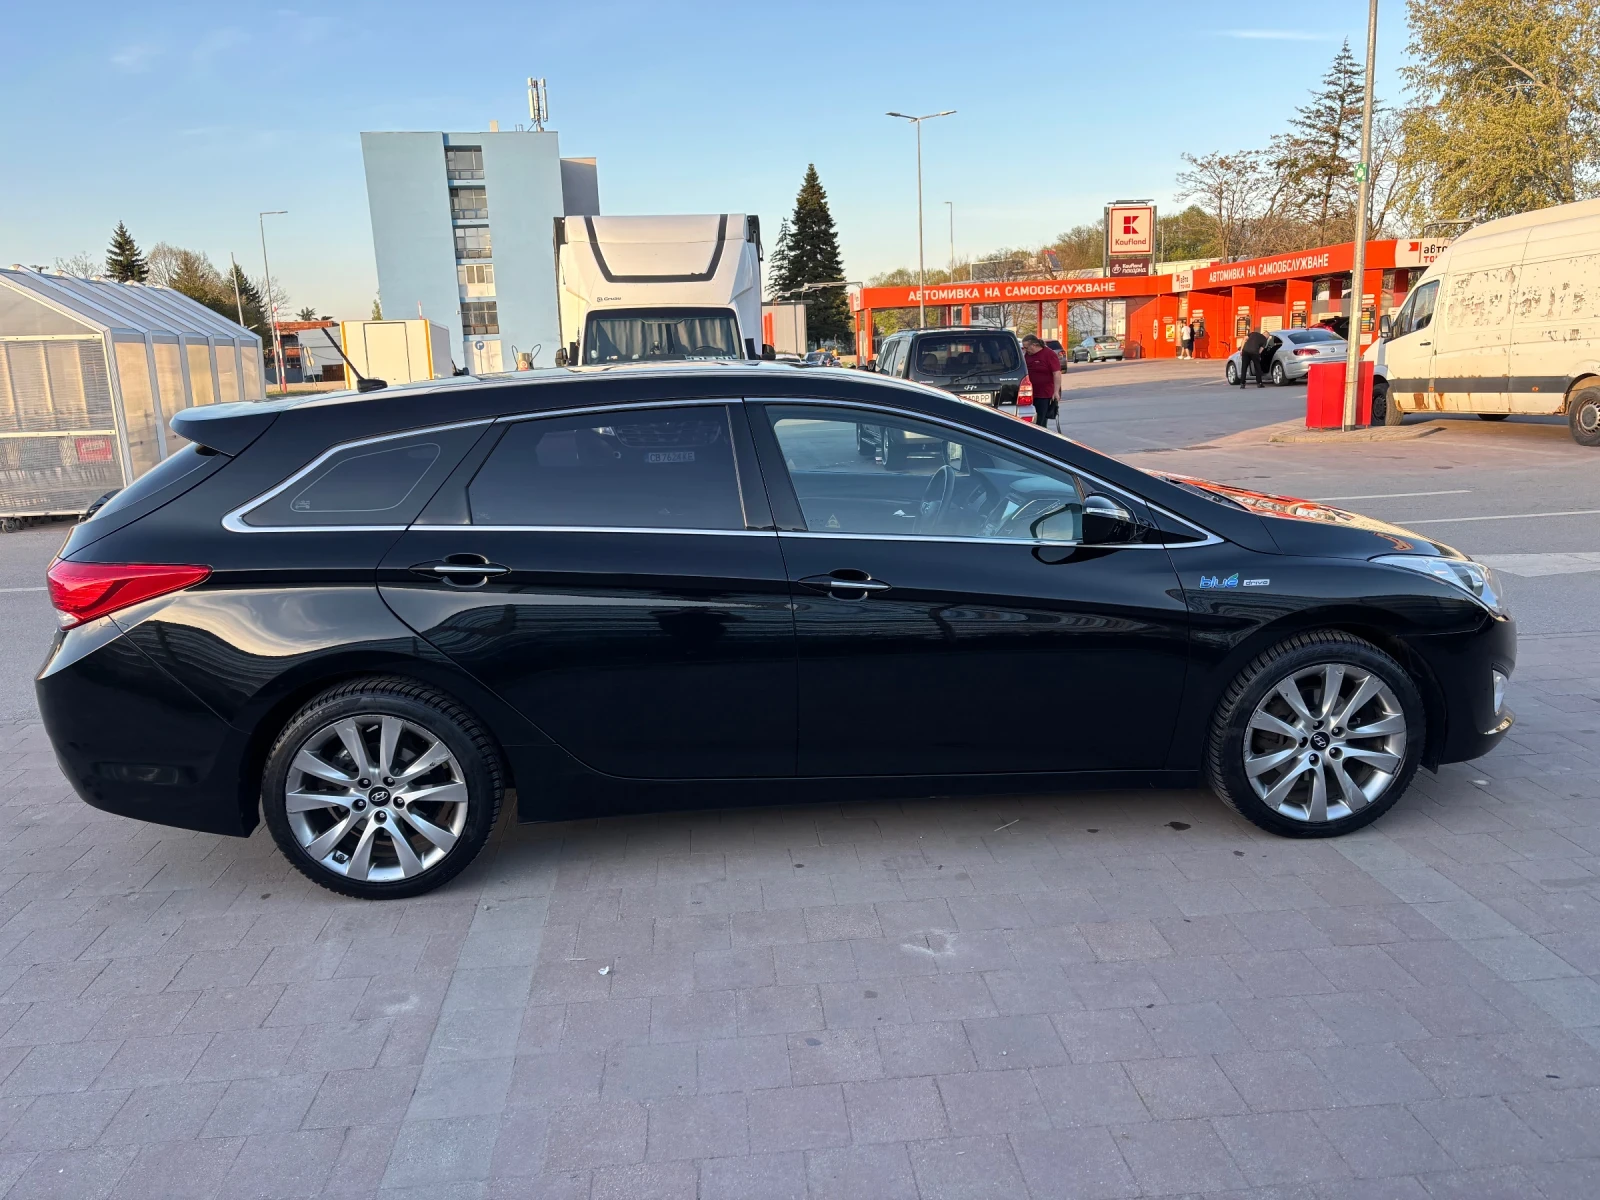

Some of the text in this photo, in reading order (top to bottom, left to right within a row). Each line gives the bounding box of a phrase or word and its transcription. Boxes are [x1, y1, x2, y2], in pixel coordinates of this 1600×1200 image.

[1115, 238, 1147, 246] Kaufland
[1209, 253, 1330, 283] АВТОМИВКА НА САМООБСЛУЖВАНЕ
[908, 282, 1116, 301] АВТОМИВКА НА САМООБСЛУЖВАНЕ
[1200, 573, 1239, 588] blue
